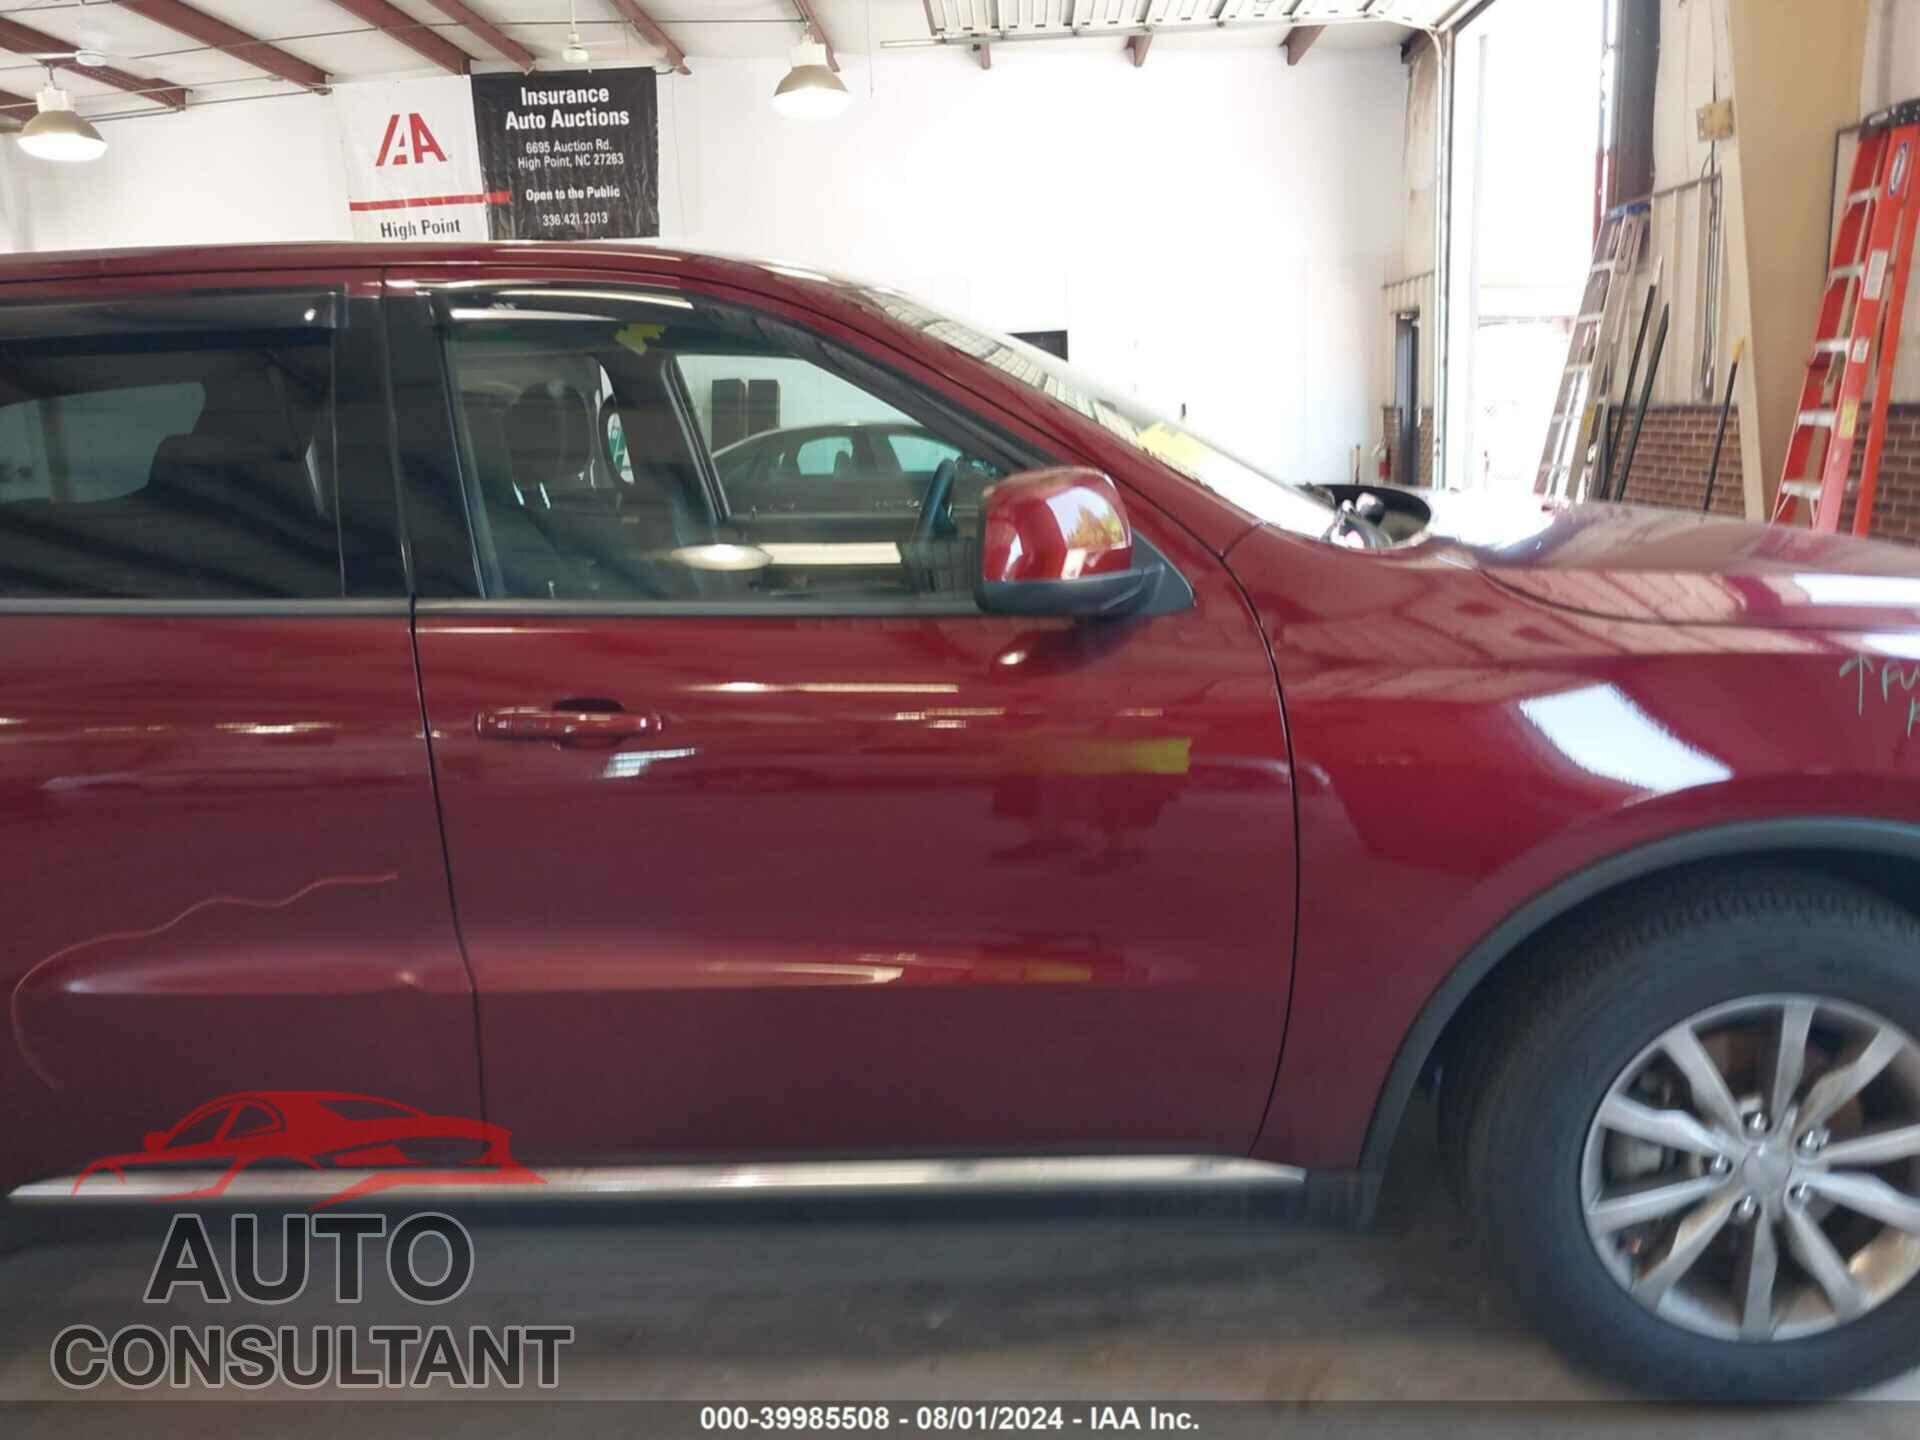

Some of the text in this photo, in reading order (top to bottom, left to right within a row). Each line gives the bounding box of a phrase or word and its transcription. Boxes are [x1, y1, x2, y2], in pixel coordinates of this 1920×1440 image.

[520, 86, 610, 106] Insurance
[505, 107, 630, 130] Auto Auctions
[526, 138, 613, 154] 6695 Auction Rd.
[517, 152, 624, 171] High Point, NC 27263
[525, 185, 621, 202] Open to the Public
[380, 218, 461, 240] High Point
